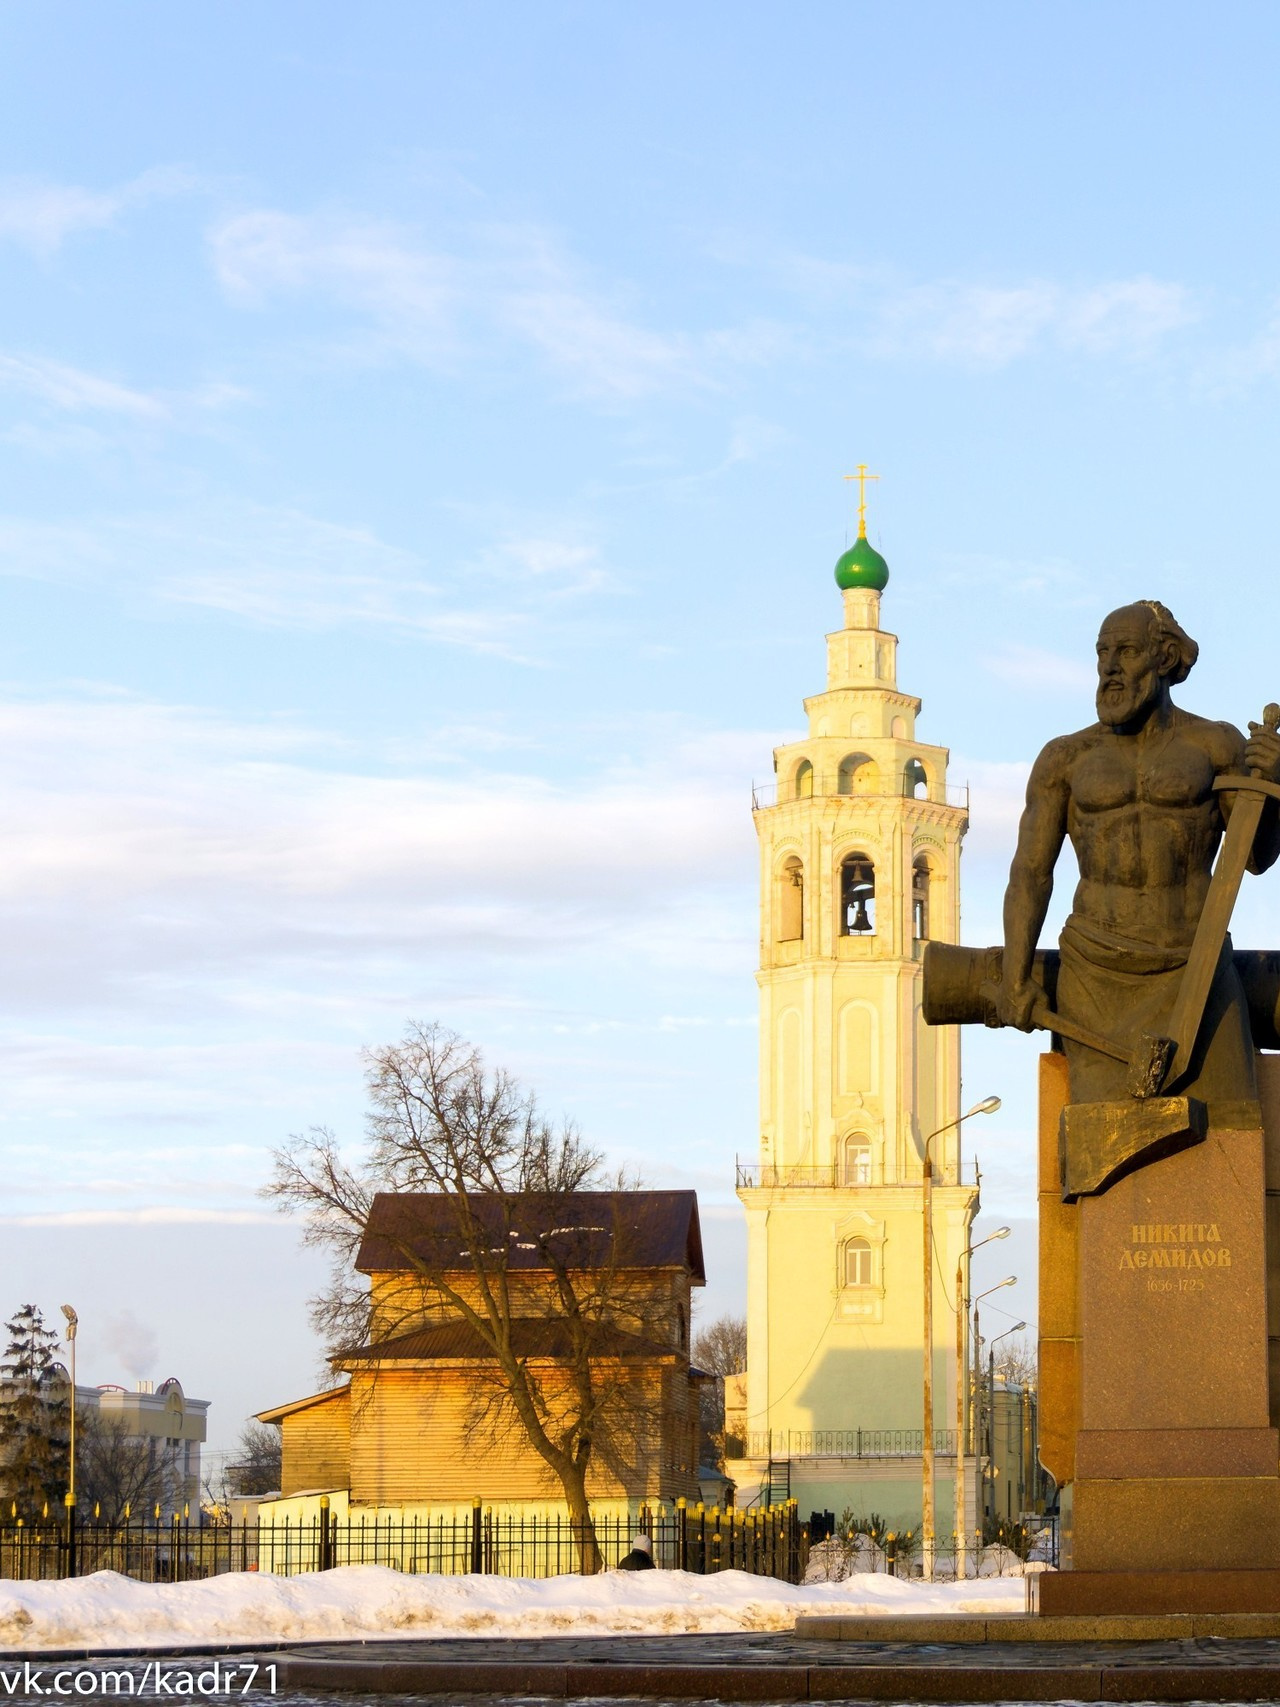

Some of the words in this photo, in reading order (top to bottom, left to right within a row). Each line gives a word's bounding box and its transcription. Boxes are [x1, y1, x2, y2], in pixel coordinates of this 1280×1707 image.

[1132, 1224, 1222, 1243] НИКИТА
[1119, 1248, 1232, 1270] ДЕМИДОВ
[1147, 1279, 1205, 1291] 1656-1725
